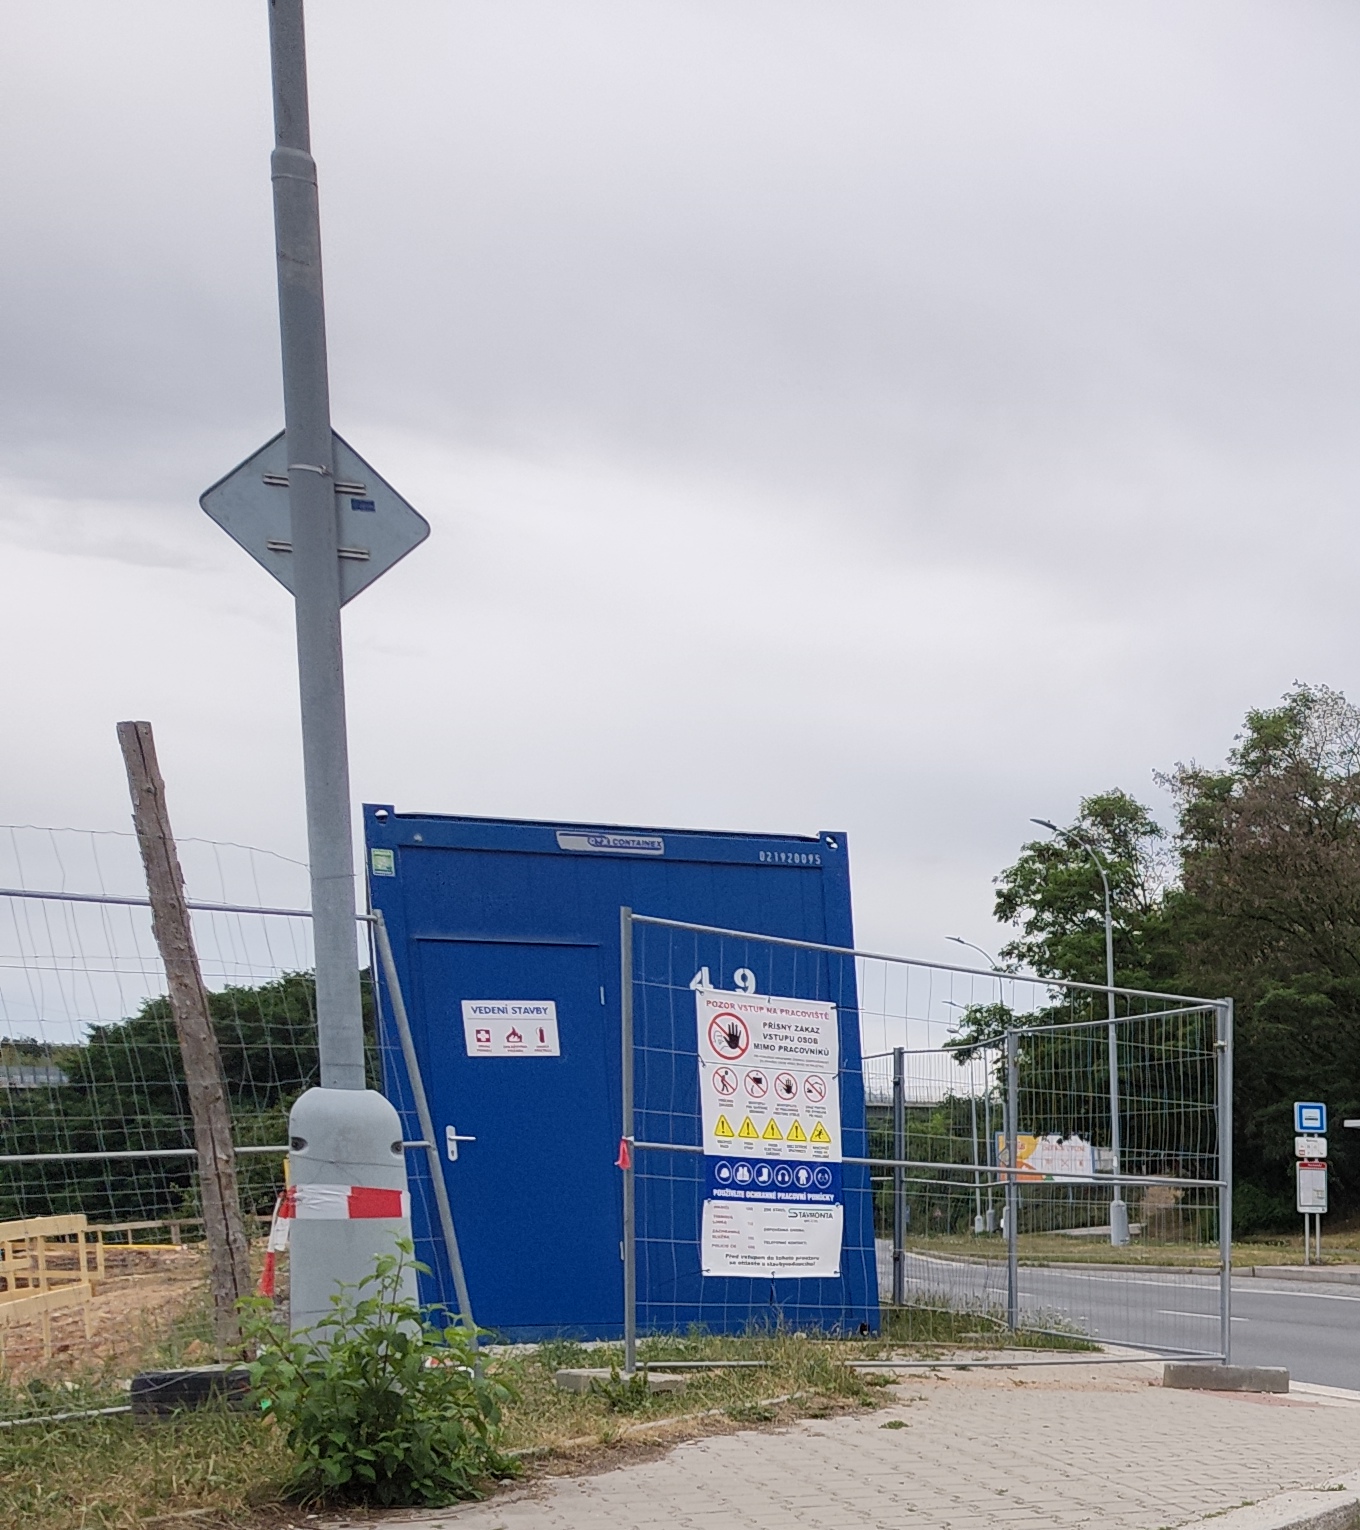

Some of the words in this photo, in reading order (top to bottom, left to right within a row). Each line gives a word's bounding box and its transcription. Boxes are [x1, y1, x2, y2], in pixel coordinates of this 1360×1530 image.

[612, 838, 662, 847] CONTAINEX
[470, 1003, 508, 1014] VEDENÍ
[511, 1006, 548, 1015] STAVBY
[706, 1000, 736, 1010] POZOR
[738, 1003, 765, 1013] VSTUP
[767, 1006, 778, 1014] NA
[762, 1033, 795, 1043] VSTUPU
[797, 1036, 819, 1045] OSOB
[753, 1042, 776, 1051] MIMO
